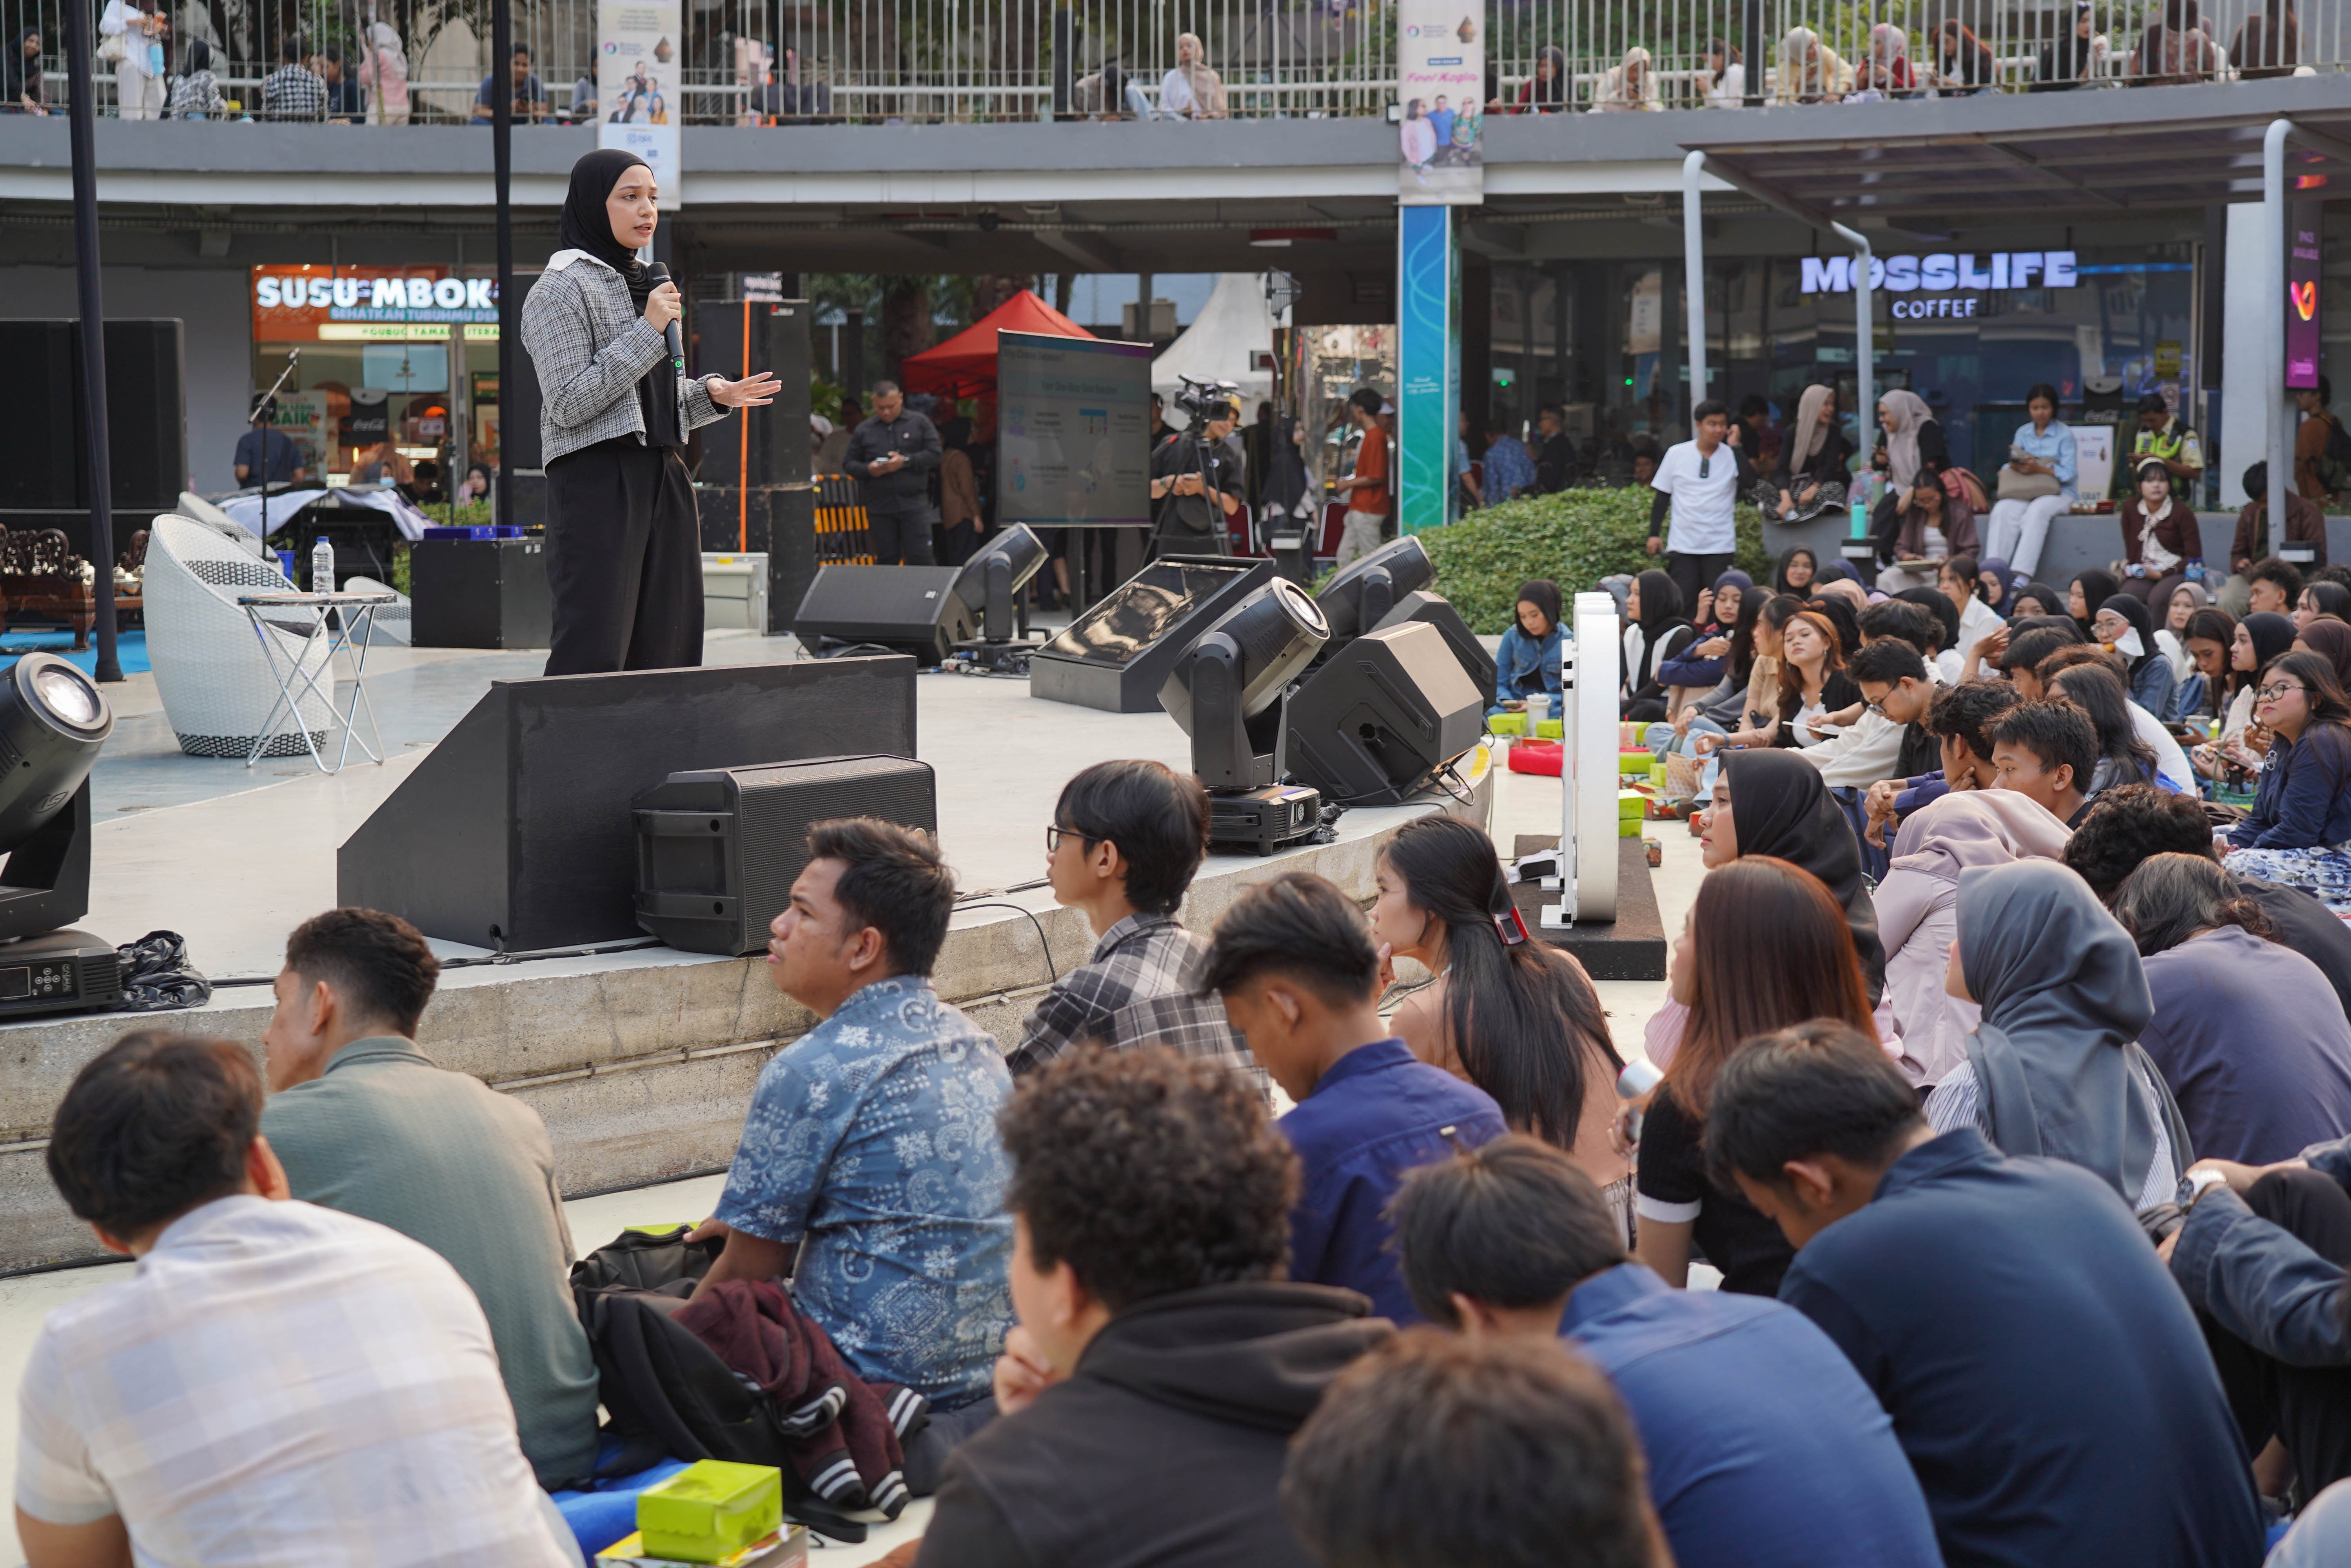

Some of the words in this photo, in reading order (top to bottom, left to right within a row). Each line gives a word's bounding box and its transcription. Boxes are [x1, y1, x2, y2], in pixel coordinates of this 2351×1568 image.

[257, 277, 358, 308] SUSU
[371, 278, 493, 309] MBOK
[330, 307, 404, 320] SEHATKAN
